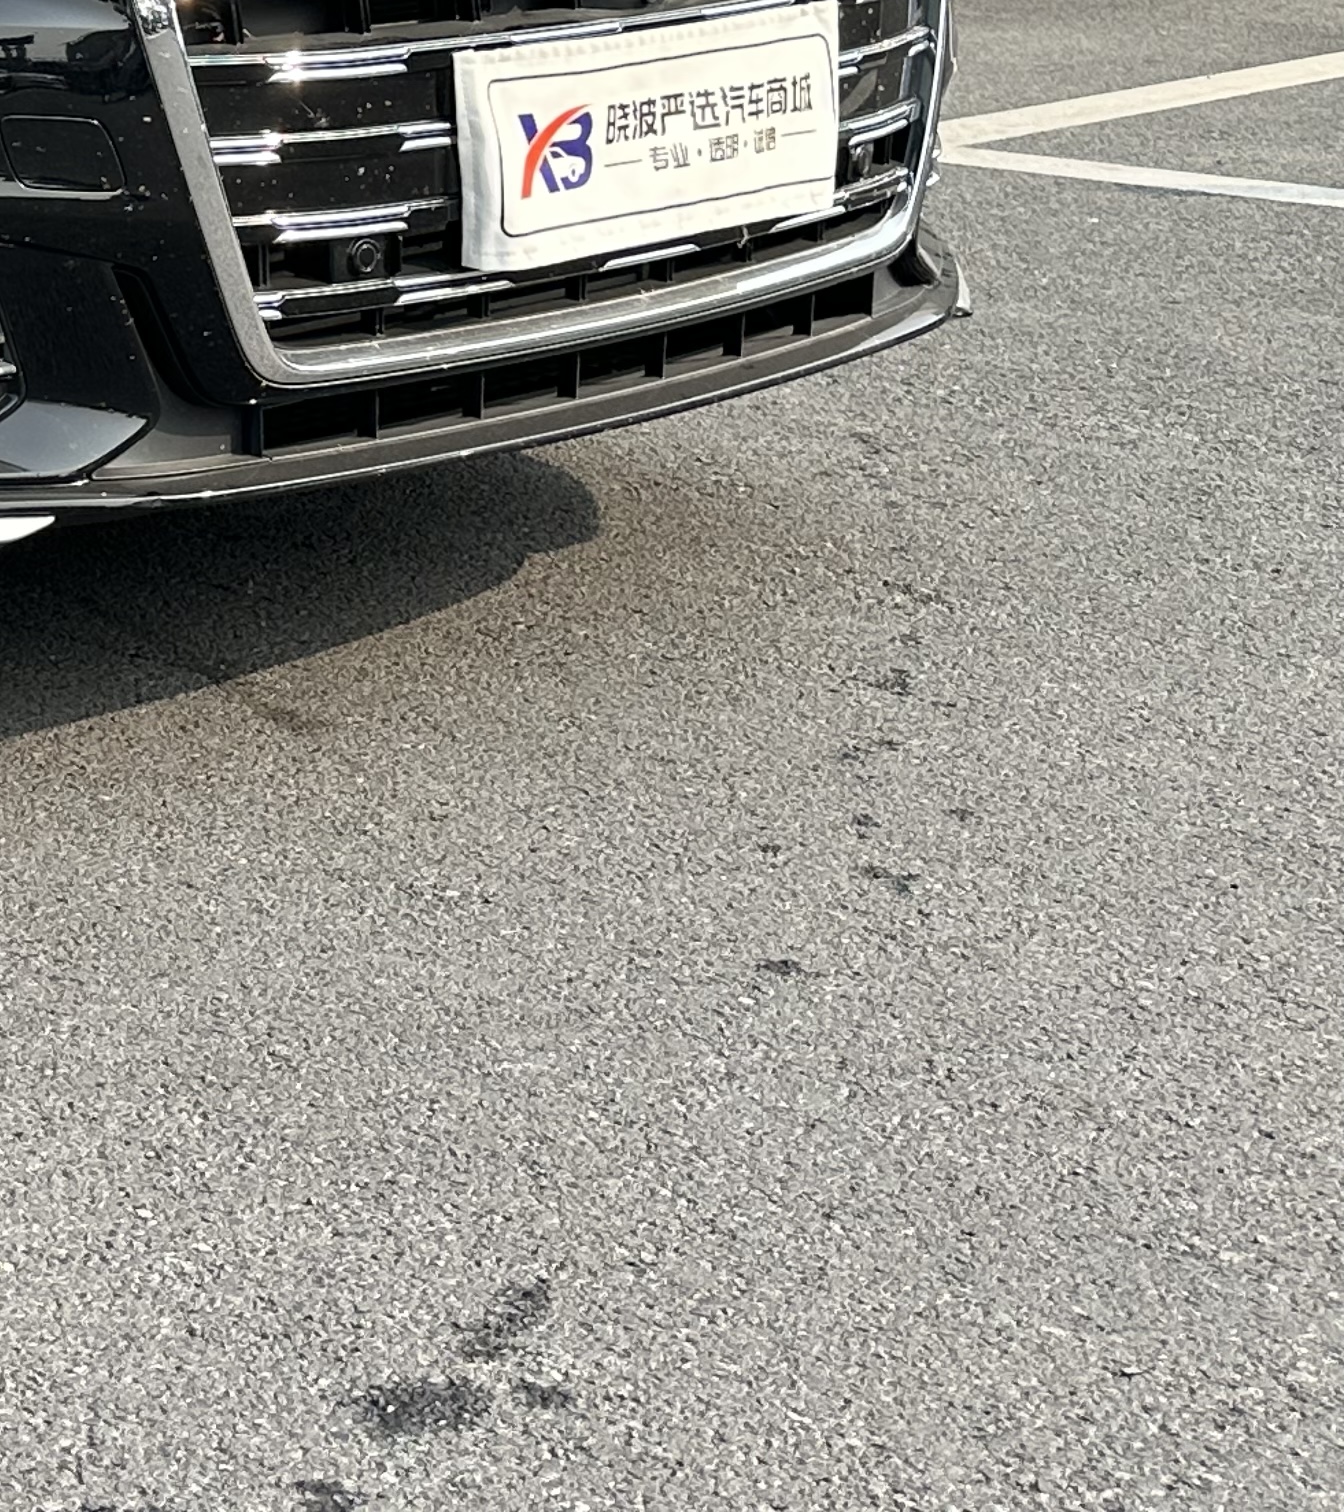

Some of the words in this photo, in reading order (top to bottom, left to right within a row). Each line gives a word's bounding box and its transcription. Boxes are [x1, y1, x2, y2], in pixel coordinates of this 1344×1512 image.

[605, 72, 813, 145] 晓波严选汽车商城
